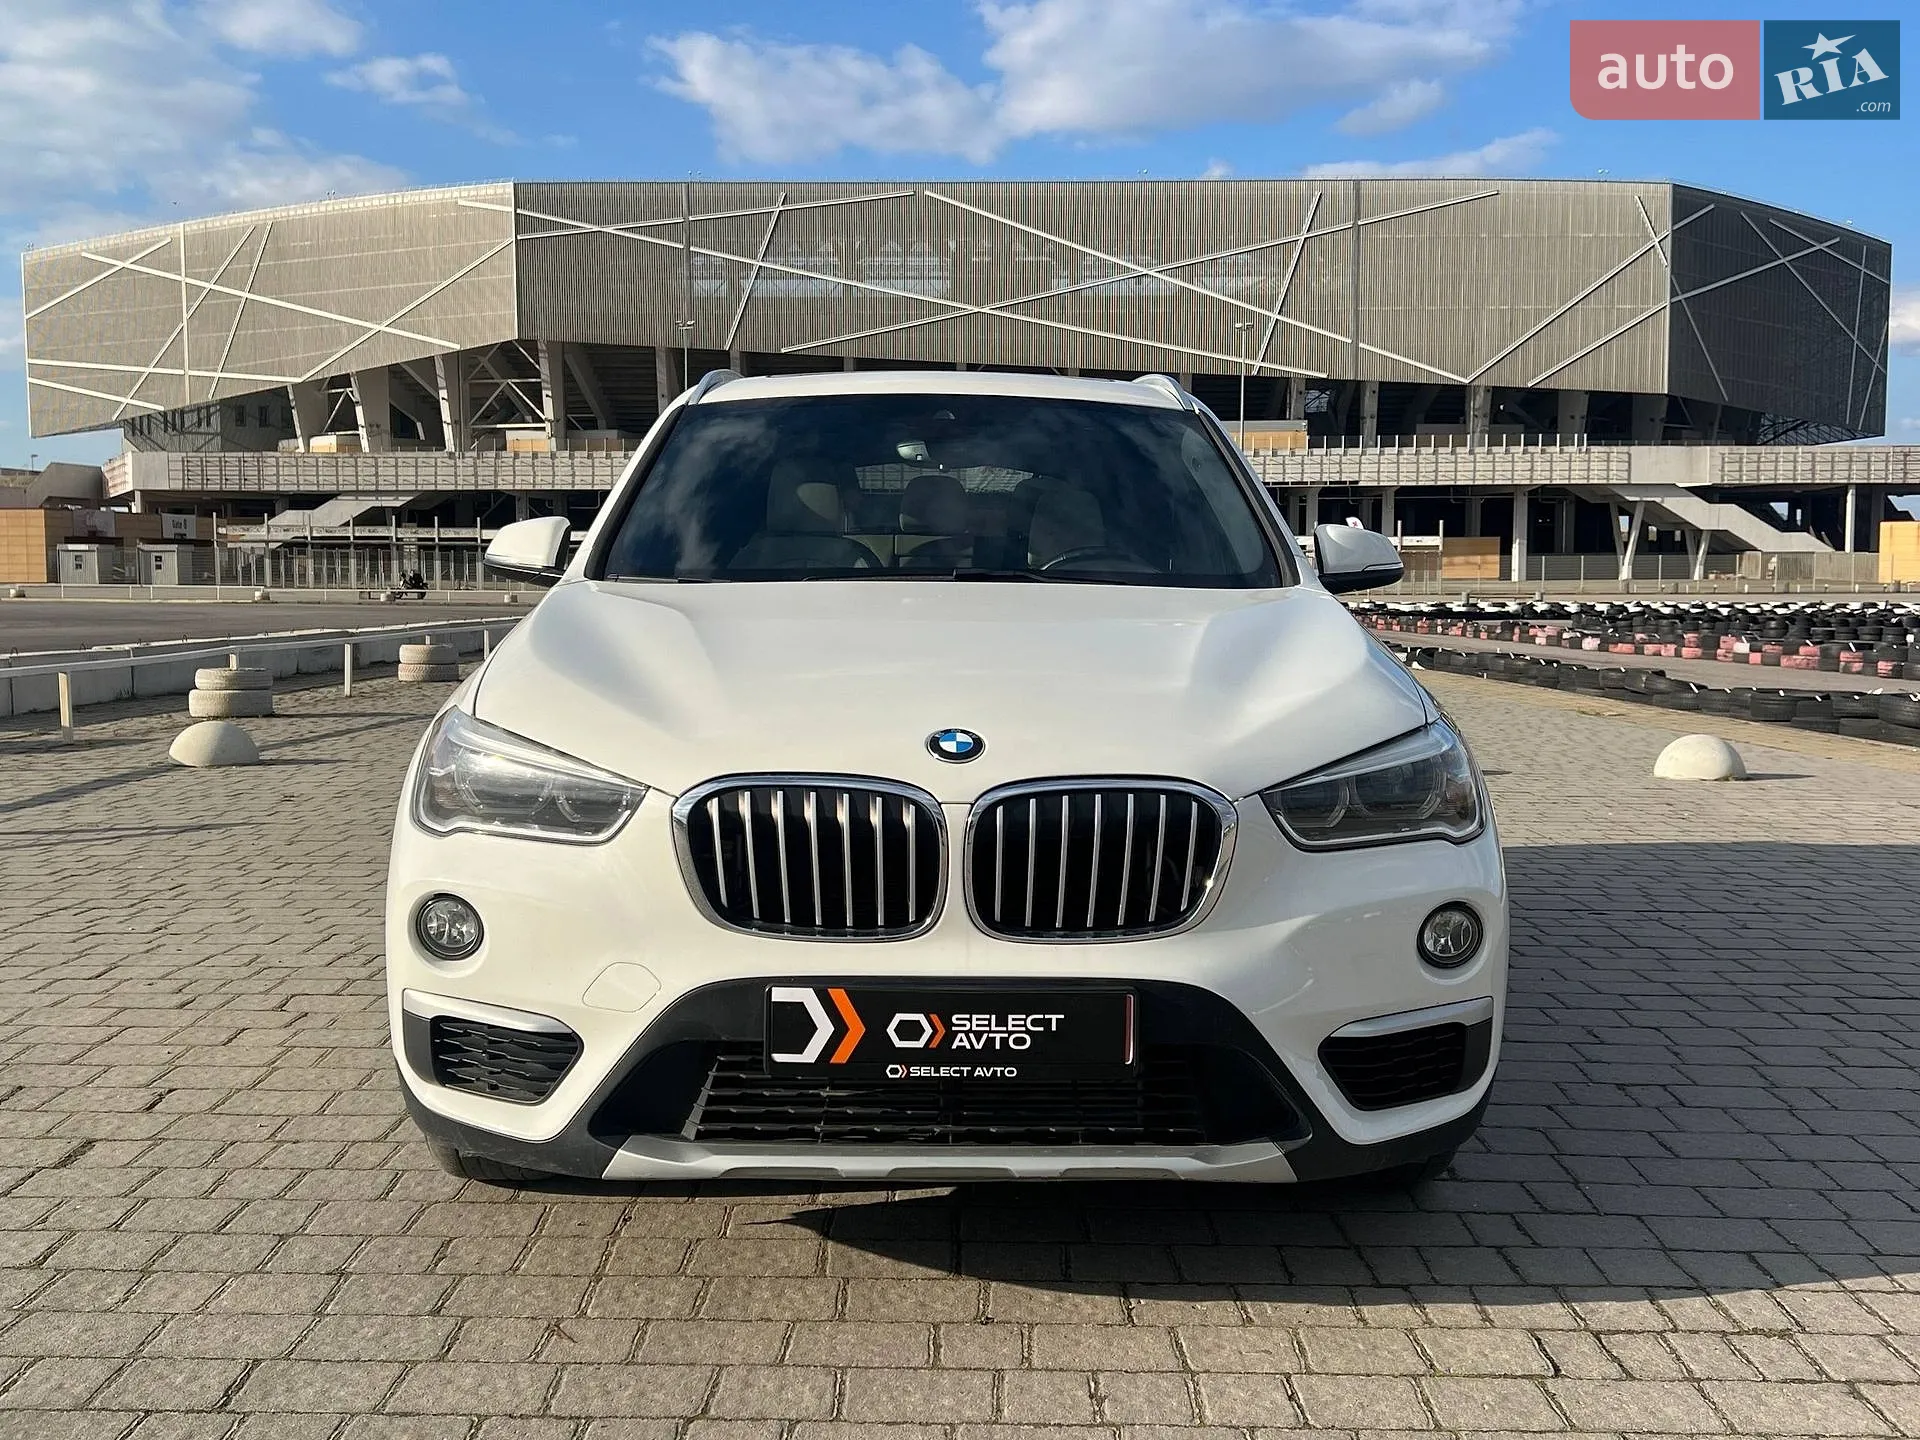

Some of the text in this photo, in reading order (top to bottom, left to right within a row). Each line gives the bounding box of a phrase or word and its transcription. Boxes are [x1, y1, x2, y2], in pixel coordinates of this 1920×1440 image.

[951, 1014, 1065, 1031] SELECT
[951, 1033, 1031, 1050] AVTO
[909, 1066, 1018, 1077] SELECT AVTO
